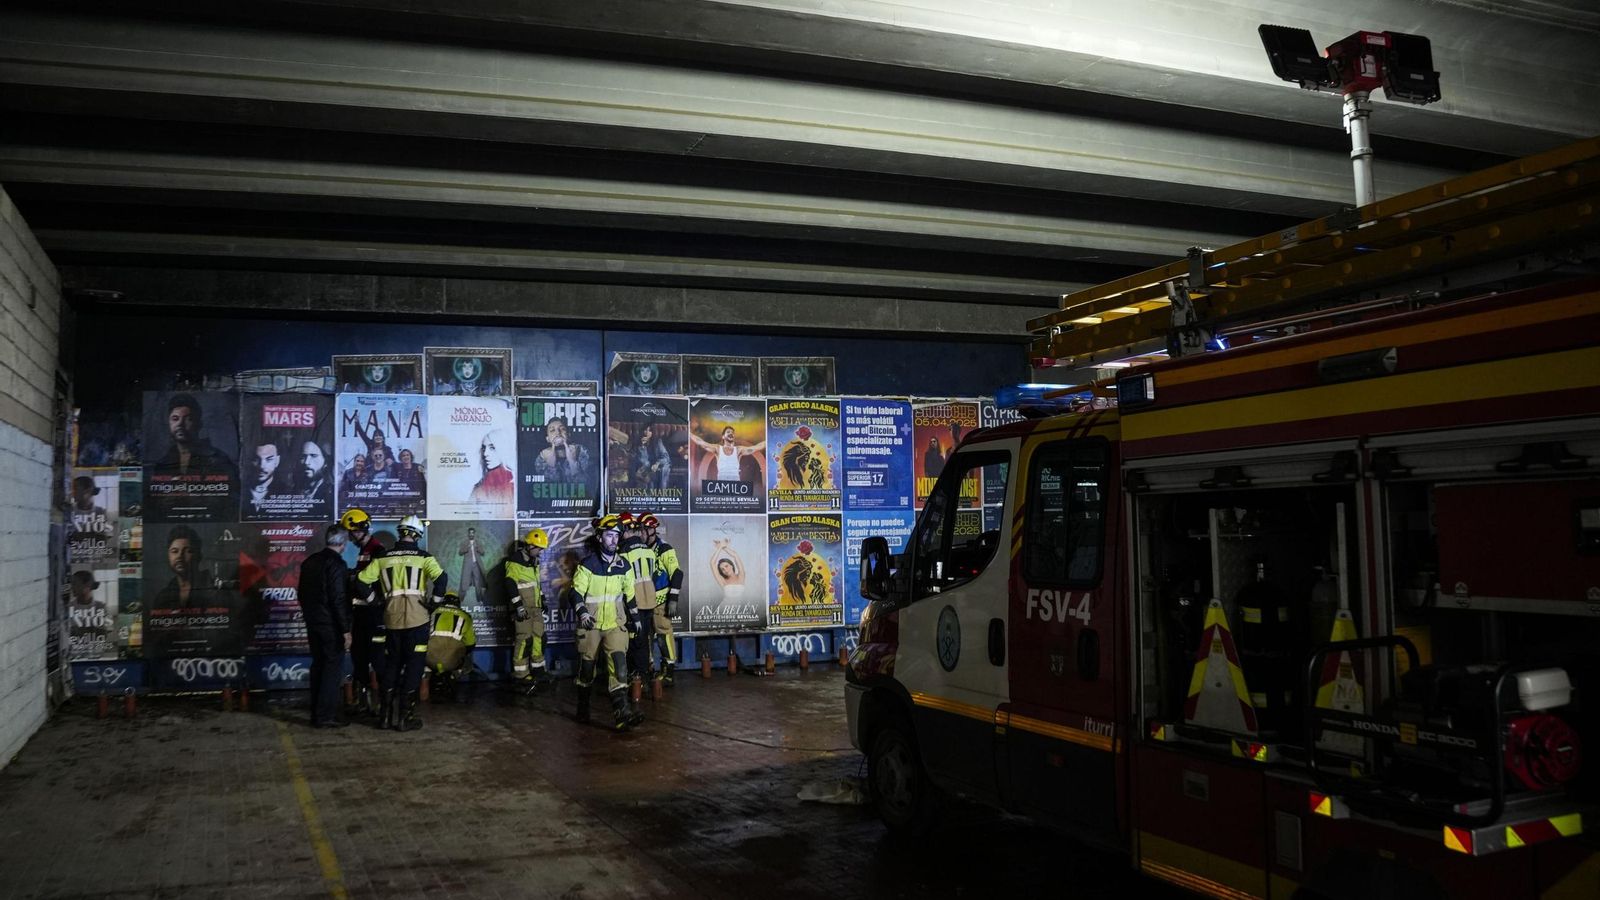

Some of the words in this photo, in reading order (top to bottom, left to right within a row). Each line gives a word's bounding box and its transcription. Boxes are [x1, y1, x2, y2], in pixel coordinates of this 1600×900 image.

[454, 405, 488, 415] MÓNICA
[769, 403, 789, 413] GRAN
[811, 402, 838, 415] ALASKA
[846, 405, 853, 414] Si
[854, 406, 862, 414] tu
[863, 406, 877, 414] vida
[878, 406, 903, 415] laboral
[265, 411, 314, 425] MARS
[450, 414, 493, 423] NARANJO
[808, 416, 839, 429] BESTIA
[846, 416, 855, 424] es
[856, 415, 871, 424] más
[915, 418, 977, 427] 05.04.2025
[846, 426, 860, 435] que
[861, 425, 868, 434] el
[872, 474, 884, 482] 17
[151, 482, 187, 493] miguel
[188, 482, 229, 493] poveda
[533, 482, 586, 499] SEVILLA
[615, 487, 649, 497] VANESA
[650, 485, 683, 497] MARTÍN
[707, 481, 749, 495] CAMILO
[770, 498, 779, 508] 11
[832, 498, 841, 508] 11
[771, 517, 790, 528] GRAN
[791, 515, 811, 523] CIRCO
[812, 516, 840, 528] ALASKA
[847, 519, 871, 527] Porque
[881, 518, 905, 527] puedes
[809, 531, 840, 543] BESTIA
[847, 528, 869, 536] seguir
[262, 587, 299, 601] PROD
[696, 604, 721, 616] ANA
[721, 600, 759, 615] BELÉN
[1026, 588, 1091, 627] FSV-4
[150, 616, 187, 627] miguel
[188, 615, 230, 626] poveda
[542, 609, 575, 623] SEVI
[771, 614, 780, 625] 11
[833, 611, 842, 623] 11
[1083, 716, 1114, 737] iturri
[1352, 719, 1401, 737] HONDA
